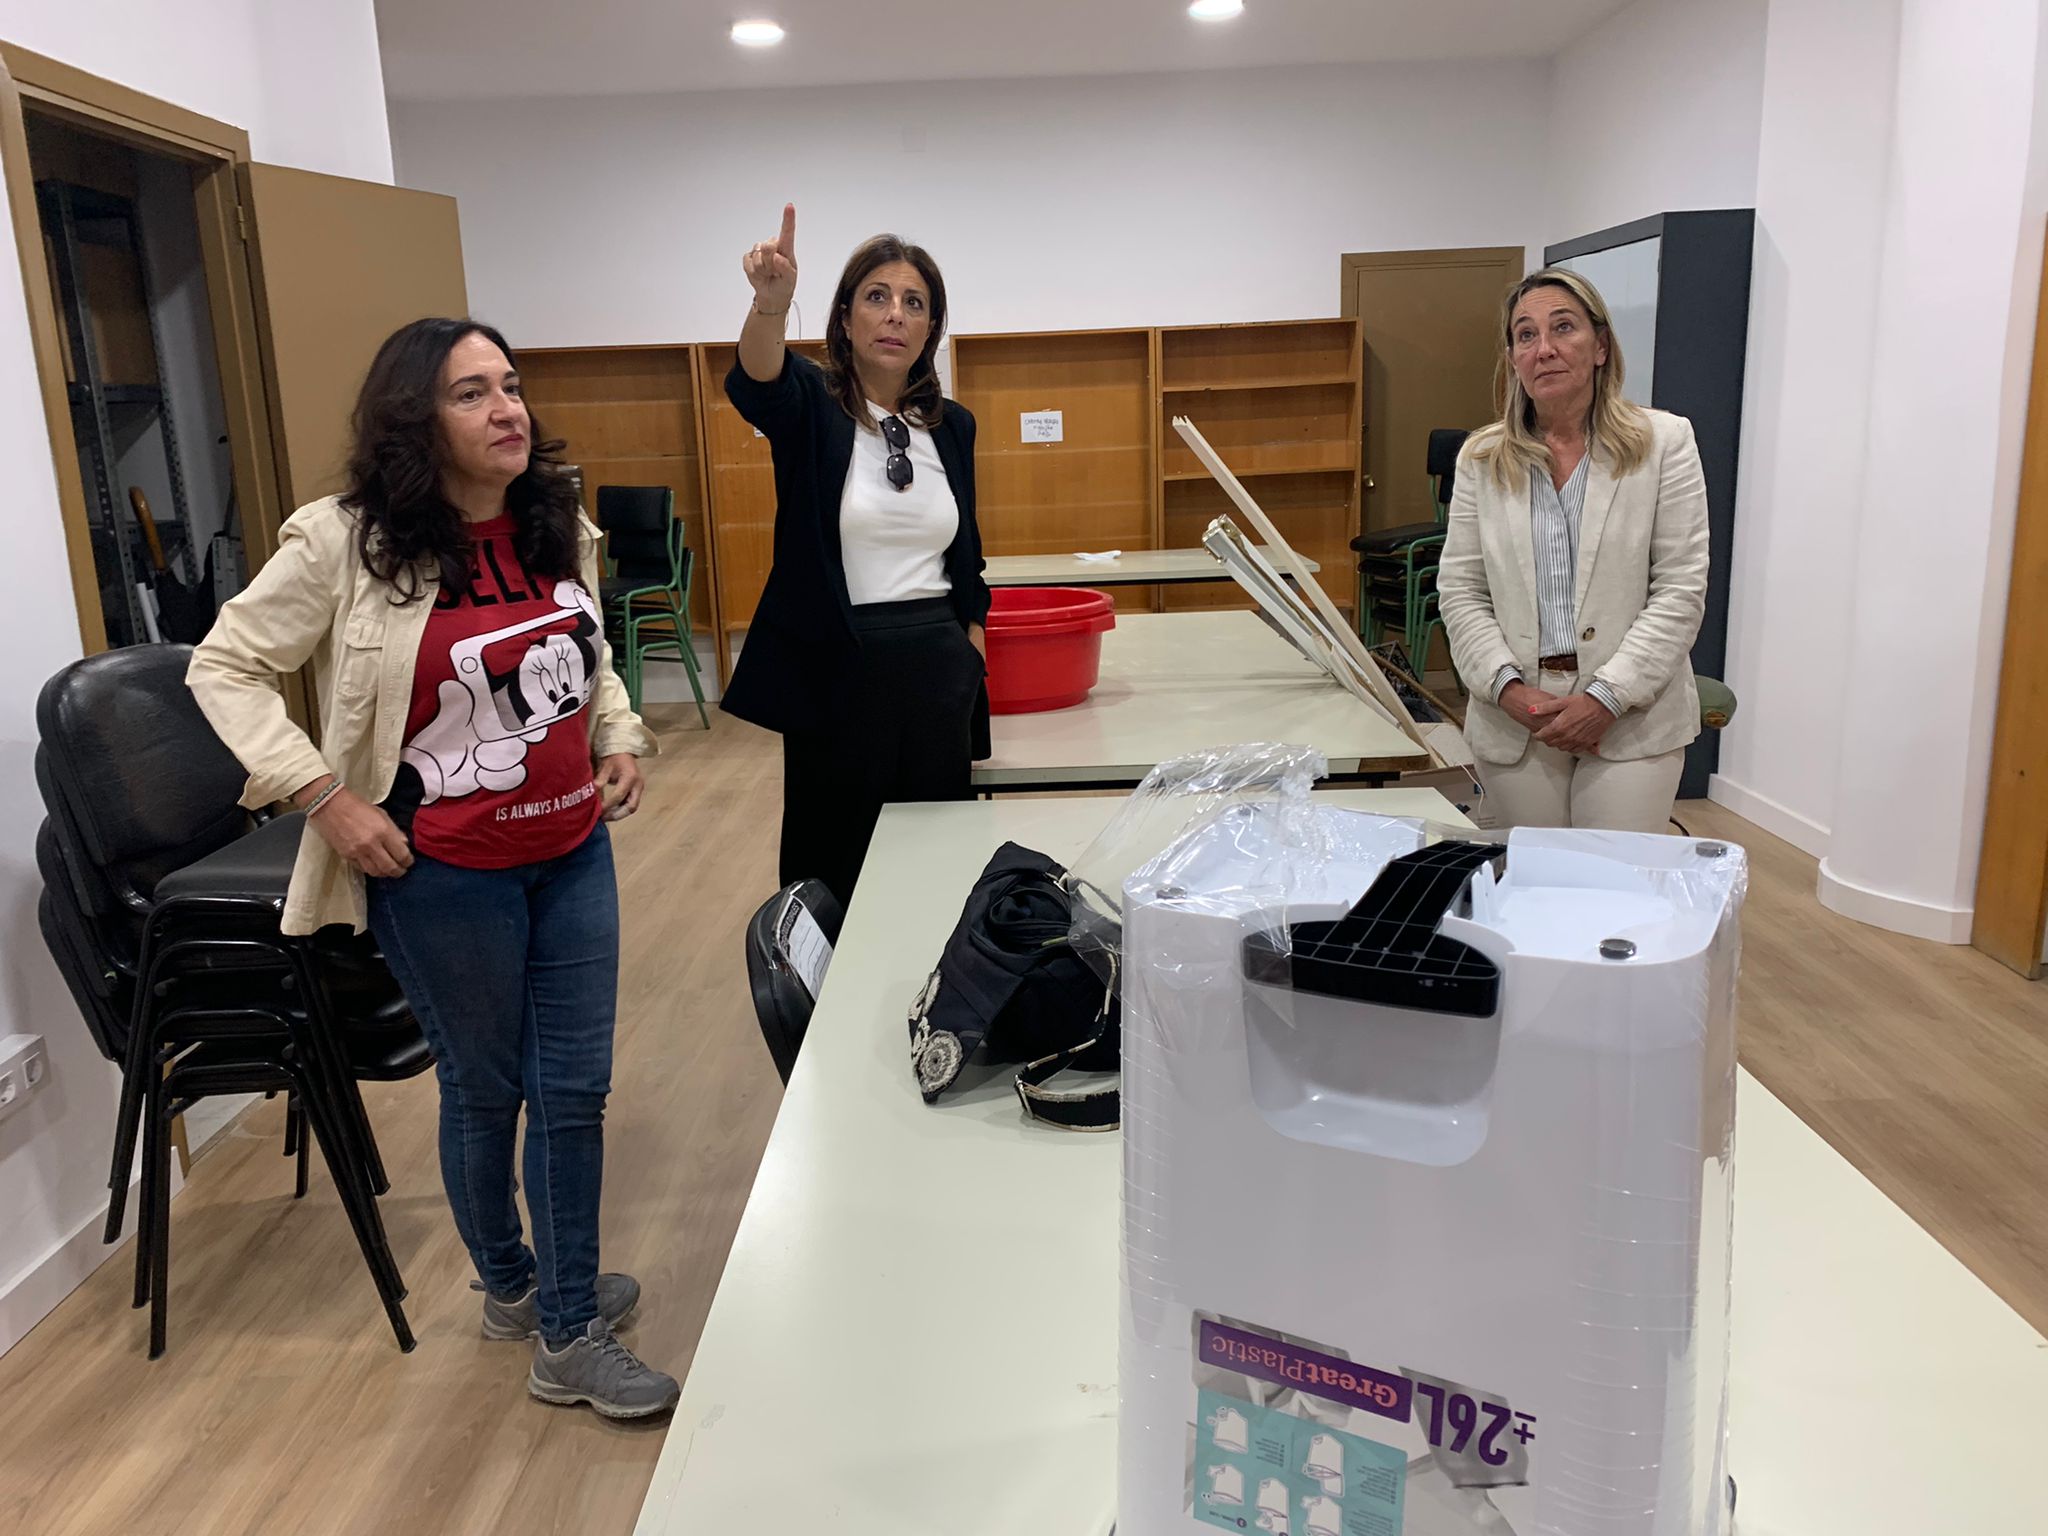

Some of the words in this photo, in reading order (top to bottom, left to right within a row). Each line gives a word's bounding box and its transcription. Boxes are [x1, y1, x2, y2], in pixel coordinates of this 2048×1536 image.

[496, 807, 508, 821] IS
[510, 800, 552, 819] ALWAYS
[552, 797, 561, 812] A
[561, 789, 581, 809] GOOD
[1211, 1334, 1398, 1409] GreatPlastic
